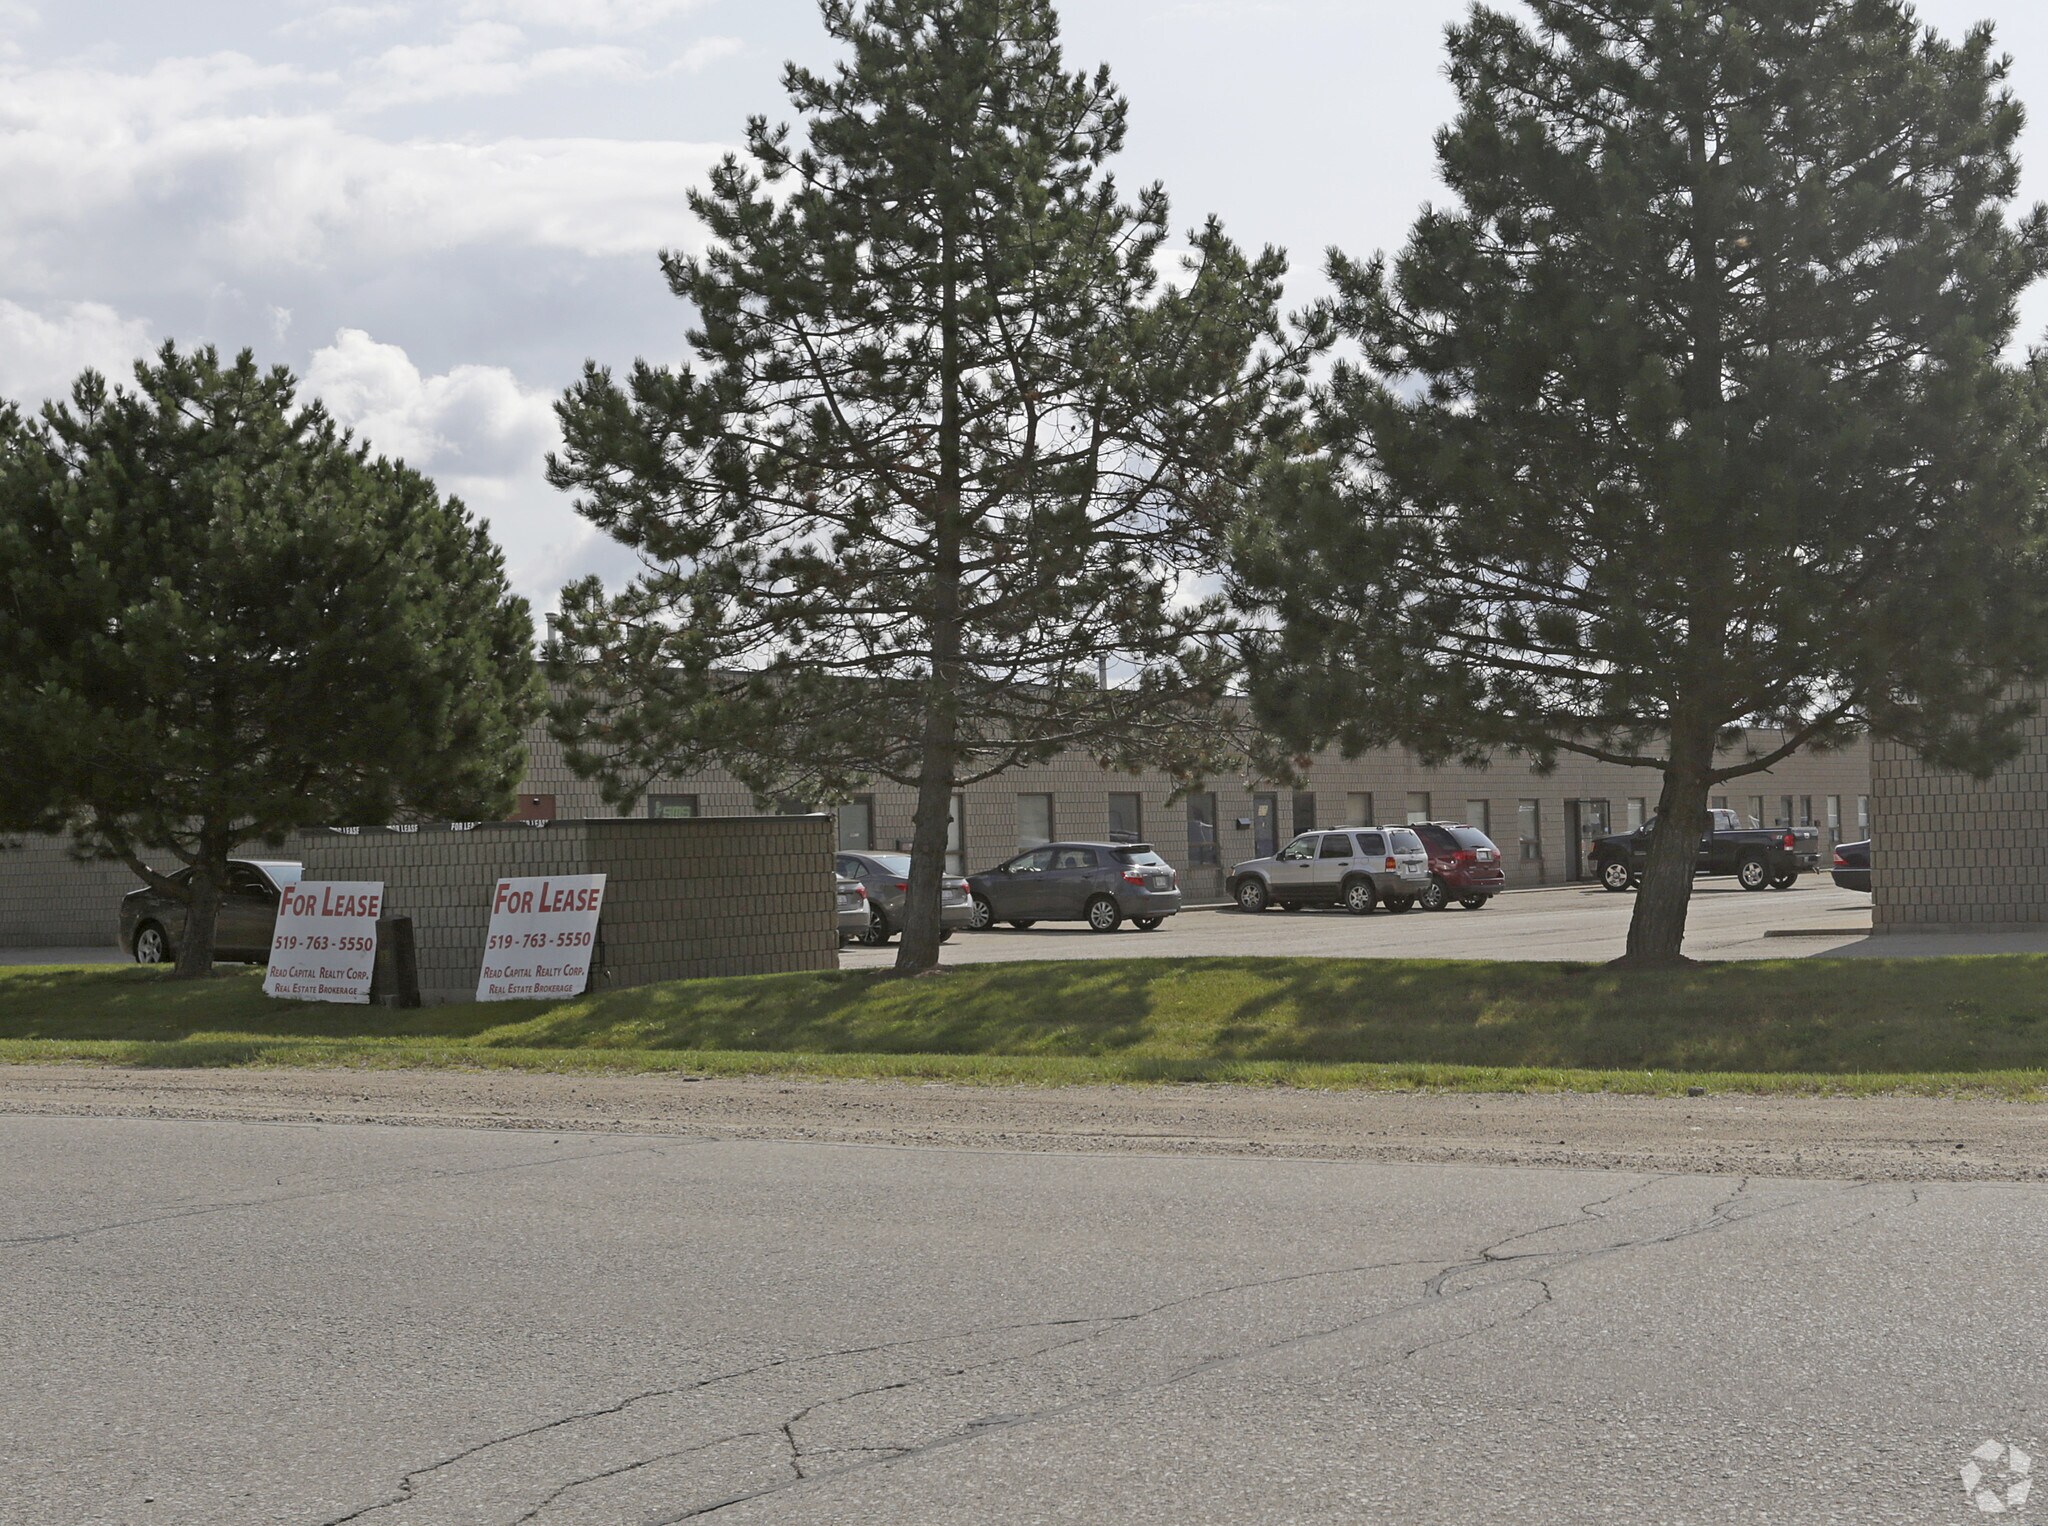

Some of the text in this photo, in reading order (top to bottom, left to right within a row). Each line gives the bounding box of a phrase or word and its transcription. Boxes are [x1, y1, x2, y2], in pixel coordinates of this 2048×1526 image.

[401, 824, 419, 833] LEASE
[451, 822, 463, 831] FOR
[280, 886, 379, 917] FOR LEASE
[494, 882, 600, 914] FOR LEASE
[270, 965, 369, 980] READ CAPITAL REALTY CORP.
[483, 964, 585, 979] READ CAPITAL REALTY CORP.
[274, 983, 358, 995] REAL ESTATE BROKERAGE
[489, 982, 573, 994] REAL ESTATE BROKERAGE
